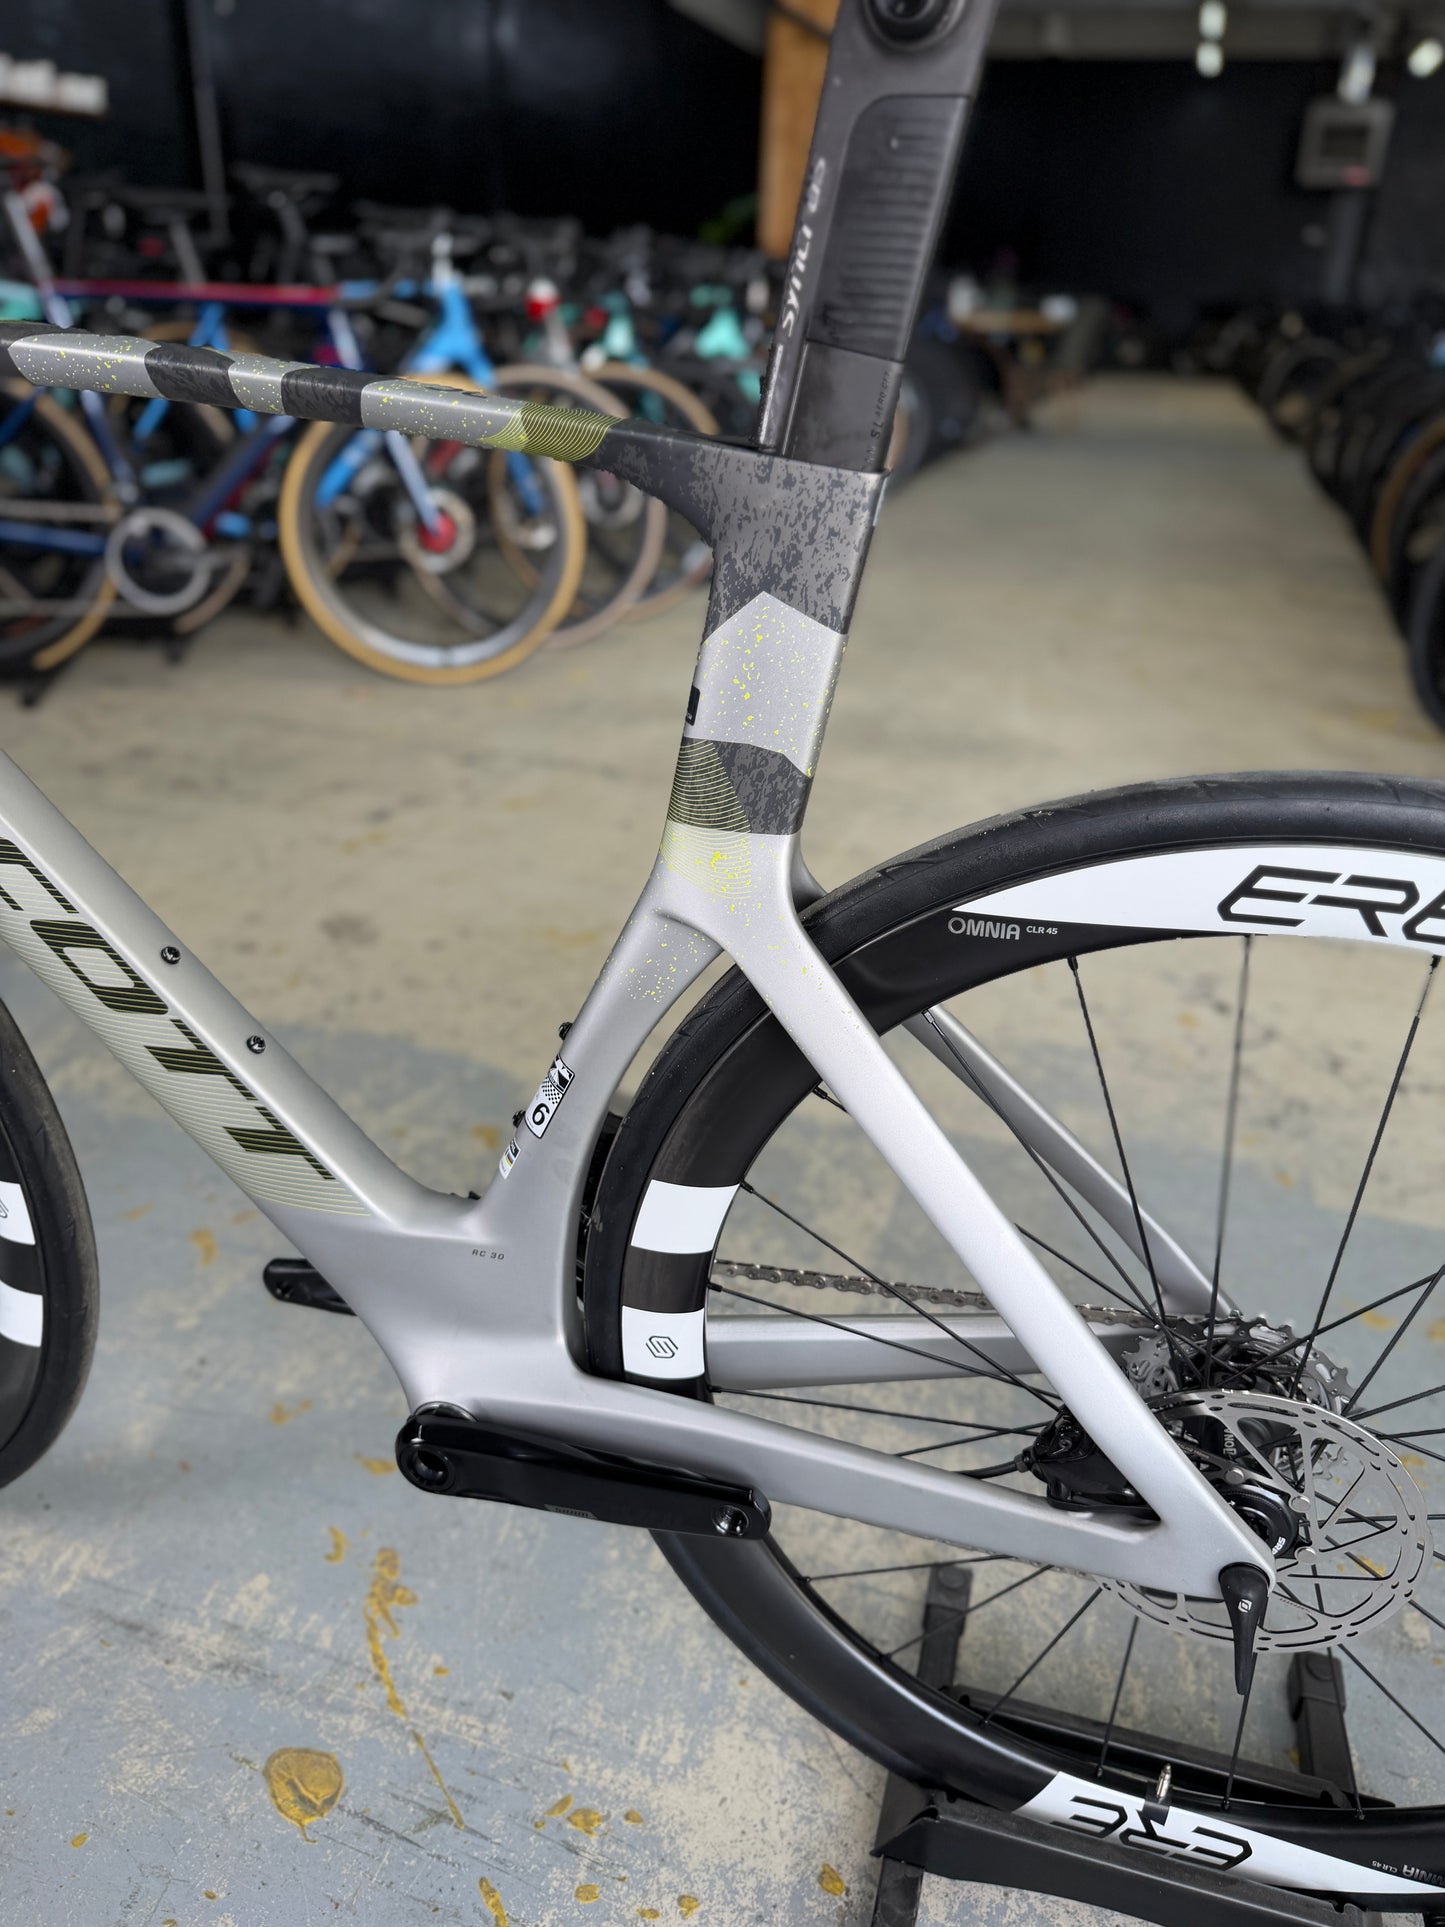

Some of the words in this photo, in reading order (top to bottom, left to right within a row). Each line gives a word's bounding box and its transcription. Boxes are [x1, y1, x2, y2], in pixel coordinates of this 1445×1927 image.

[947, 916, 1020, 941] OMNIA
[1025, 924, 1045, 935] CLR
[1045, 926, 1058, 935] 45
[471, 1248, 486, 1258] RC
[490, 1251, 505, 1260] 30
[1371, 1860, 1382, 1869] 45
[1382, 1863, 1398, 1874] CLR
